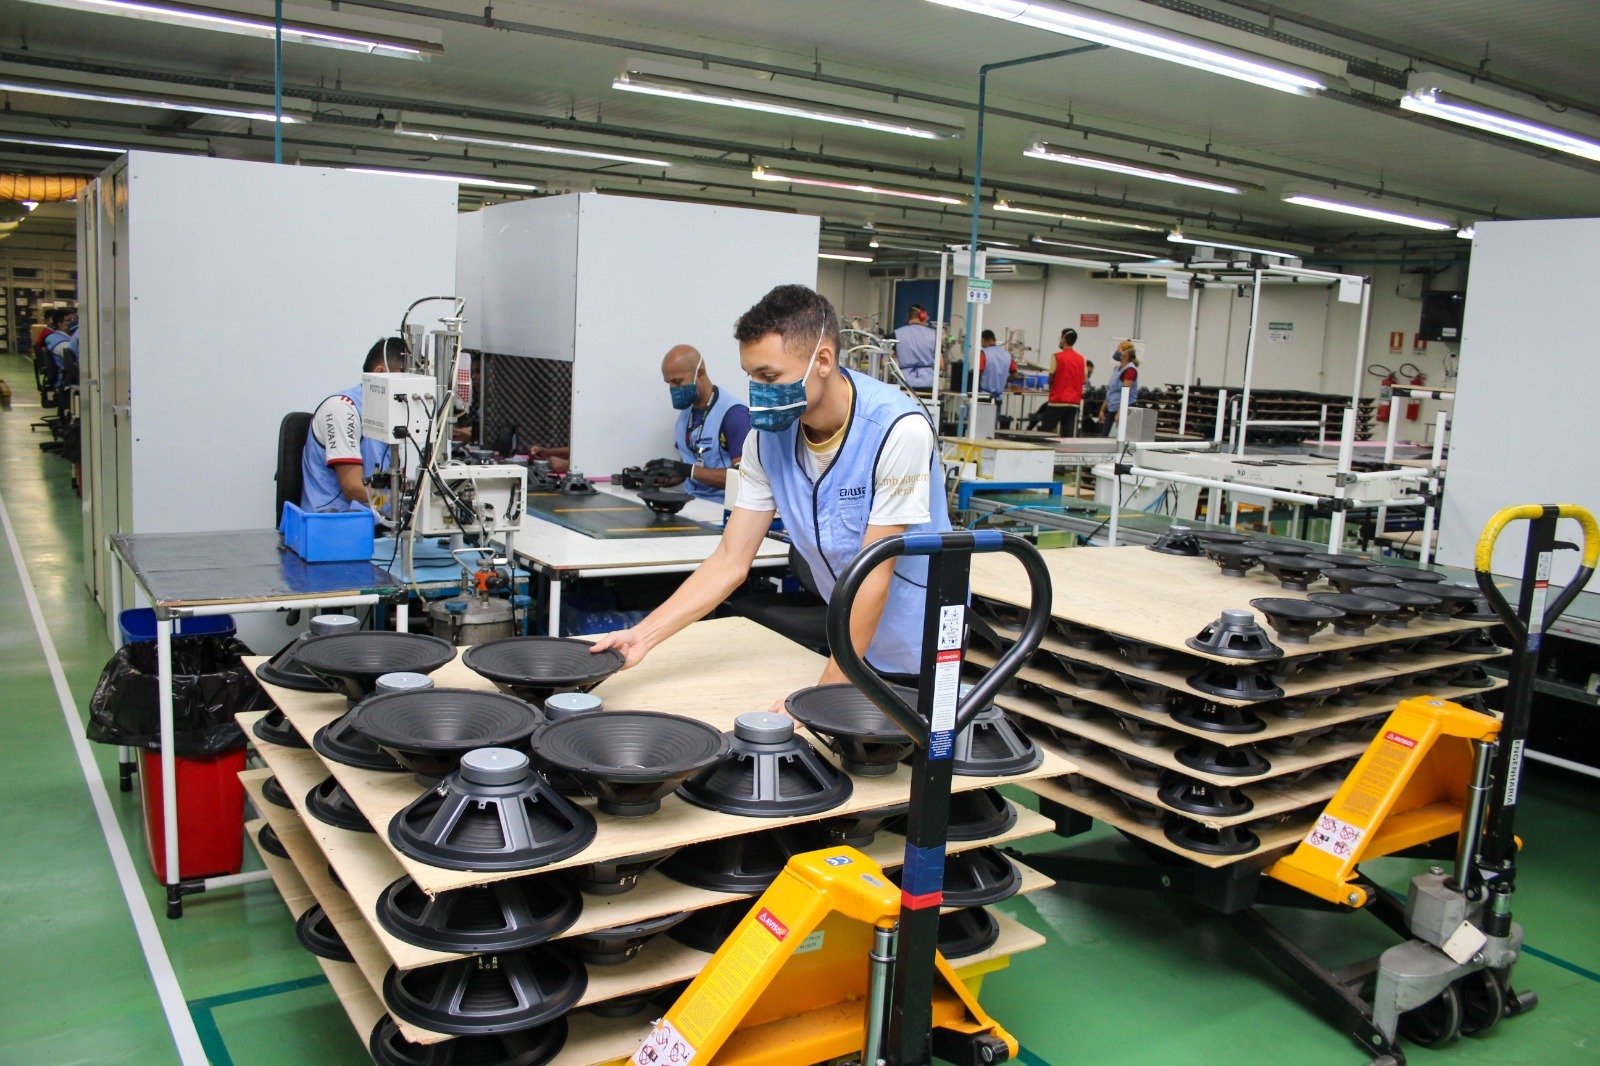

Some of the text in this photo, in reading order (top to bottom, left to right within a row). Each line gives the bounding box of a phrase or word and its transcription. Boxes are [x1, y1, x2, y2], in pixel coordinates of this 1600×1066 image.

[325, 413, 337, 449] HAVAN
[346, 412, 356, 448] HAVAN
[1393, 735, 1415, 748] AVISO!
[1506, 740, 1521, 805] ENGENHARIA
